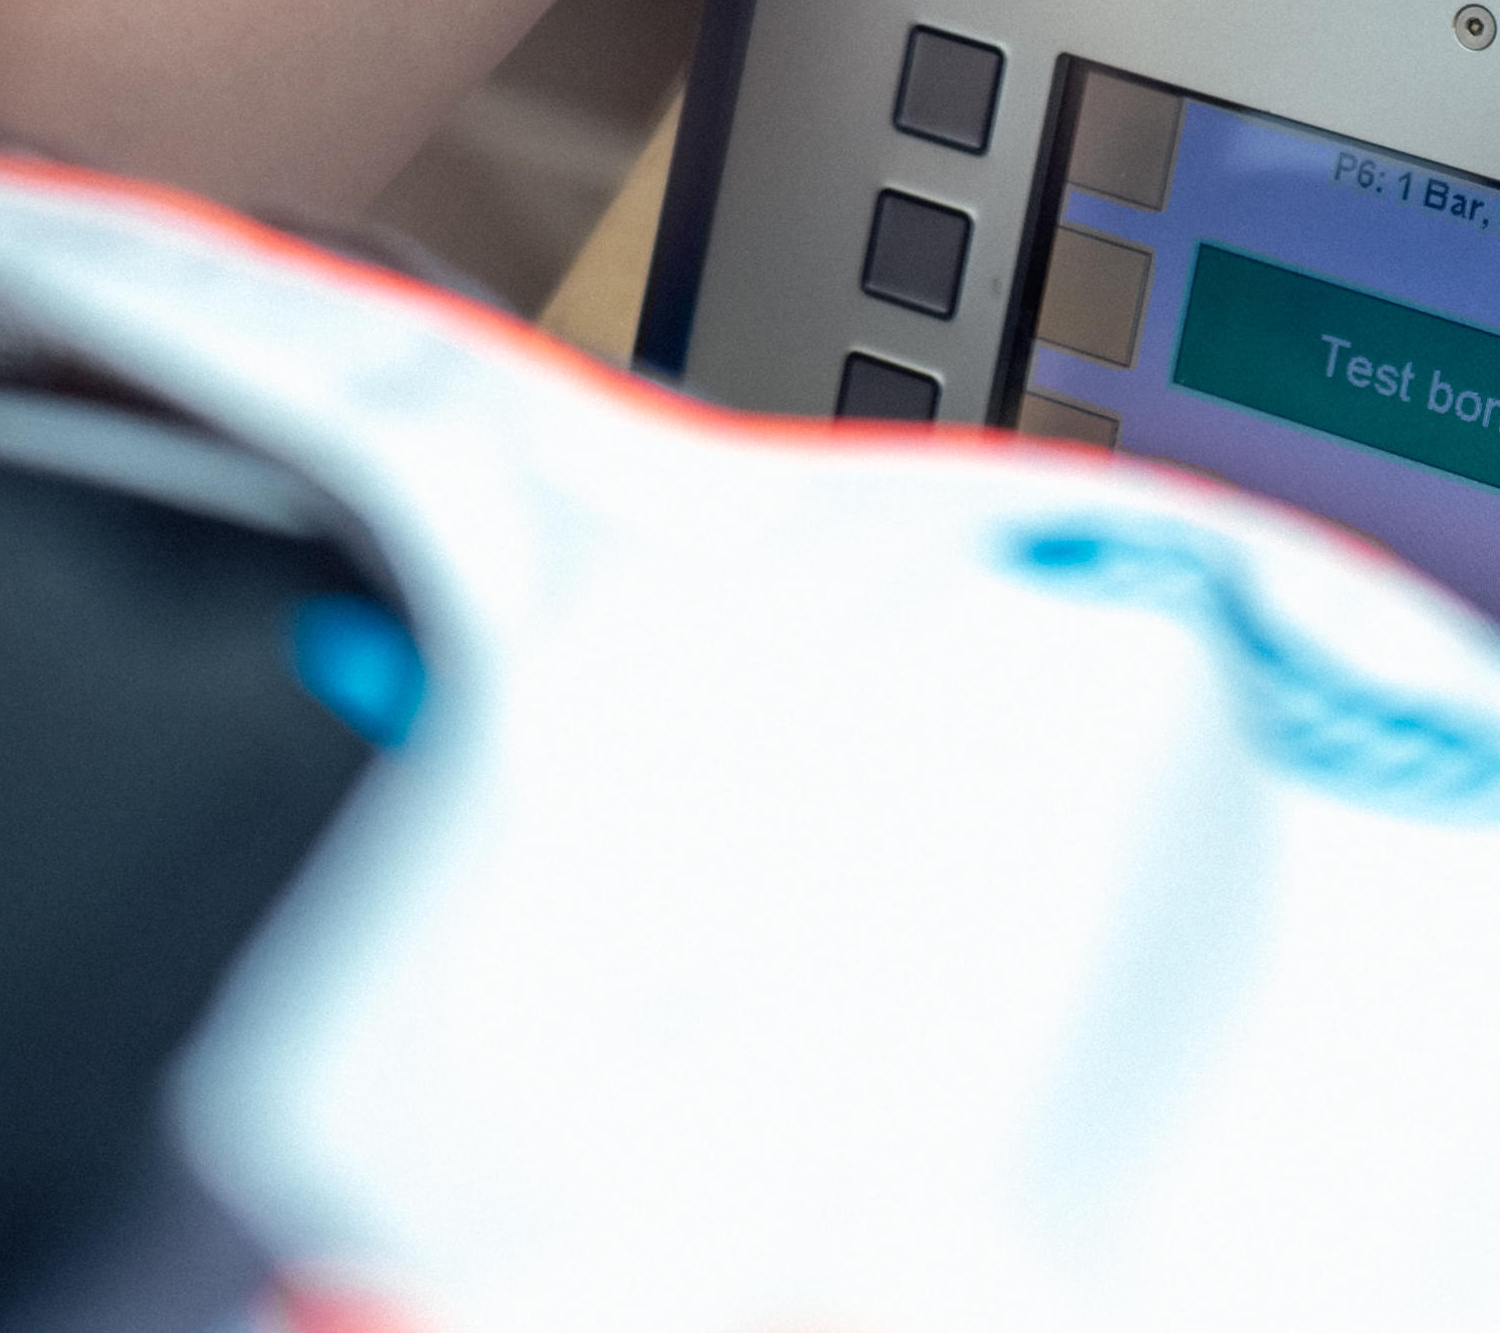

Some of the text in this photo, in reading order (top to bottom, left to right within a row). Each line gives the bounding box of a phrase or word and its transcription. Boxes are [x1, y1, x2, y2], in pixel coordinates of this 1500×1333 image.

[1334, 150, 1386, 194] P6:
[1397, 171, 1412, 201] 1
[1423, 178, 1490, 230] Bar,
[1321, 333, 1415, 403] Test
